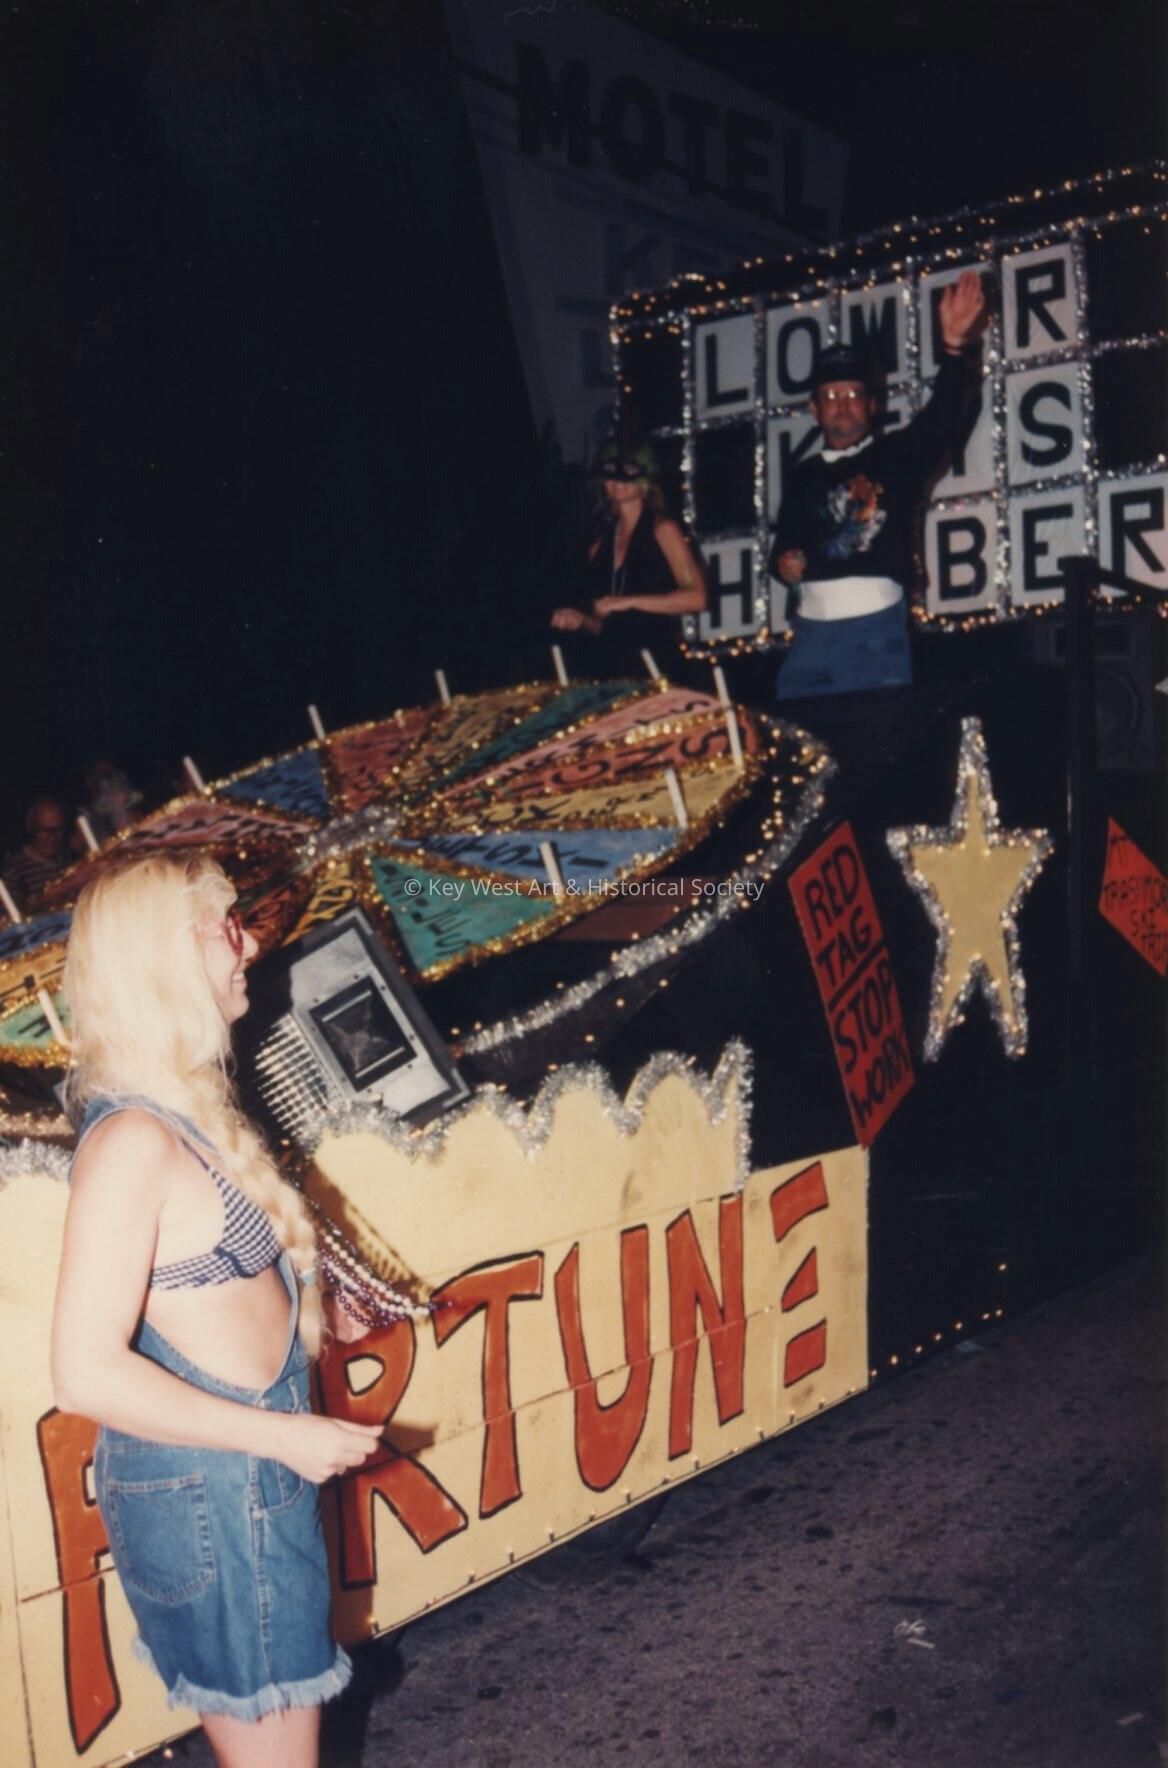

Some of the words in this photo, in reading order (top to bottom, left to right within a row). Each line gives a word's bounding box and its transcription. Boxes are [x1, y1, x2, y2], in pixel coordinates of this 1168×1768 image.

[514, 40, 830, 240] MOTEL
[804, 843, 860, 943] RED
[817, 905, 872, 988] TAG
[834, 957, 893, 1074] STOP
[36, 1160, 830, 1755] FRTUNE
